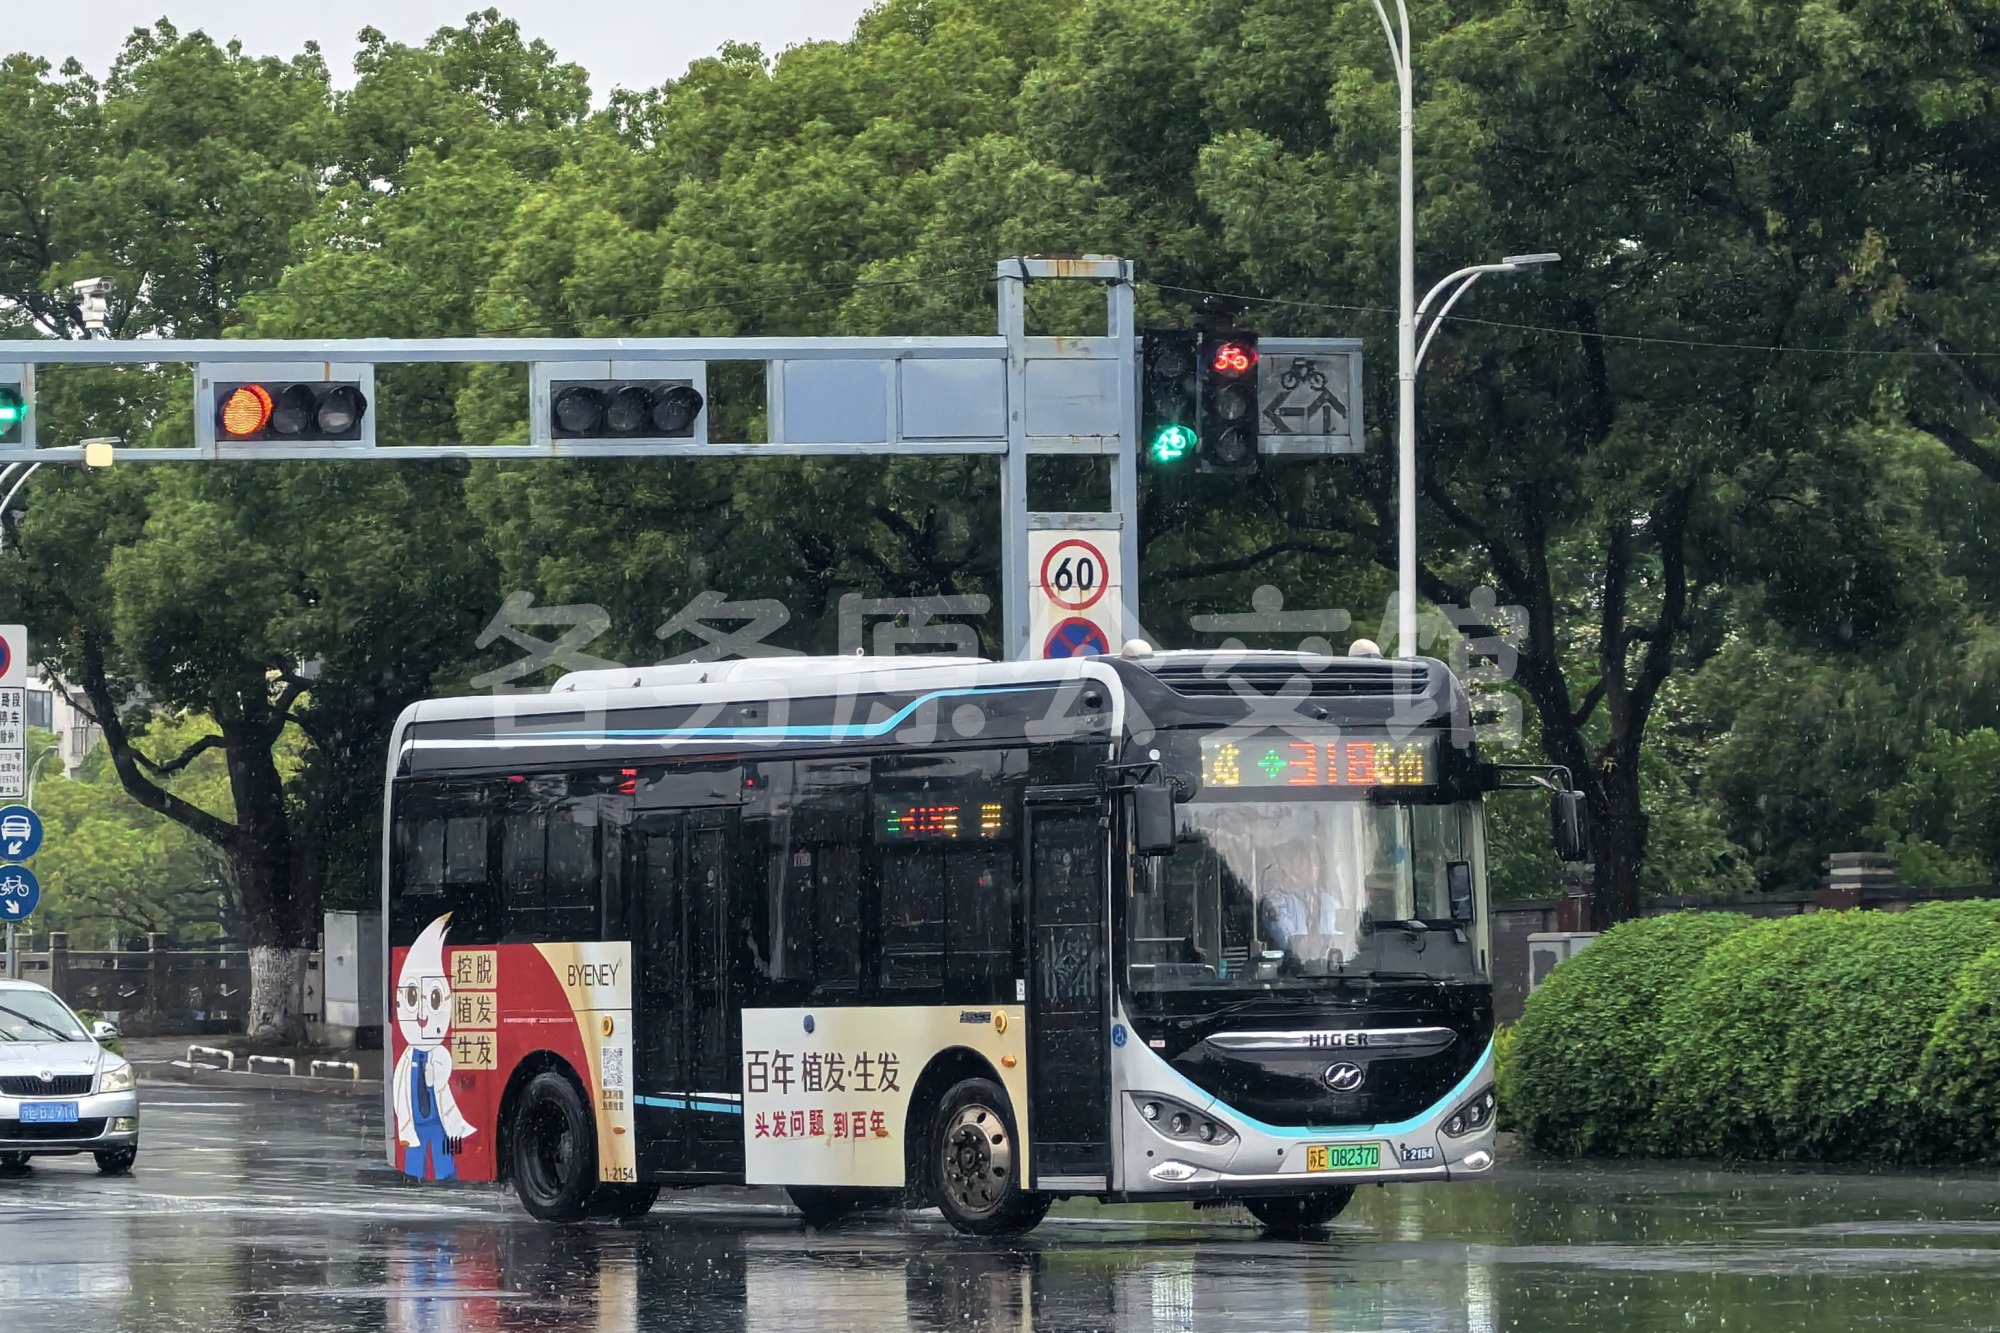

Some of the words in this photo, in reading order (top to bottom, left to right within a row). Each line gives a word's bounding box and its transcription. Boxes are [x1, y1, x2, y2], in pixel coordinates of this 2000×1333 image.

[1054, 556, 1094, 591] 60
[456, 953, 493, 986] 控脱
[567, 962, 620, 988] BYENEY
[456, 994, 493, 1026] 植发
[456, 1035, 493, 1066] 生发
[1308, 1032, 1369, 1047] HIGER
[1402, 1147, 1434, 1161] 1-2154
